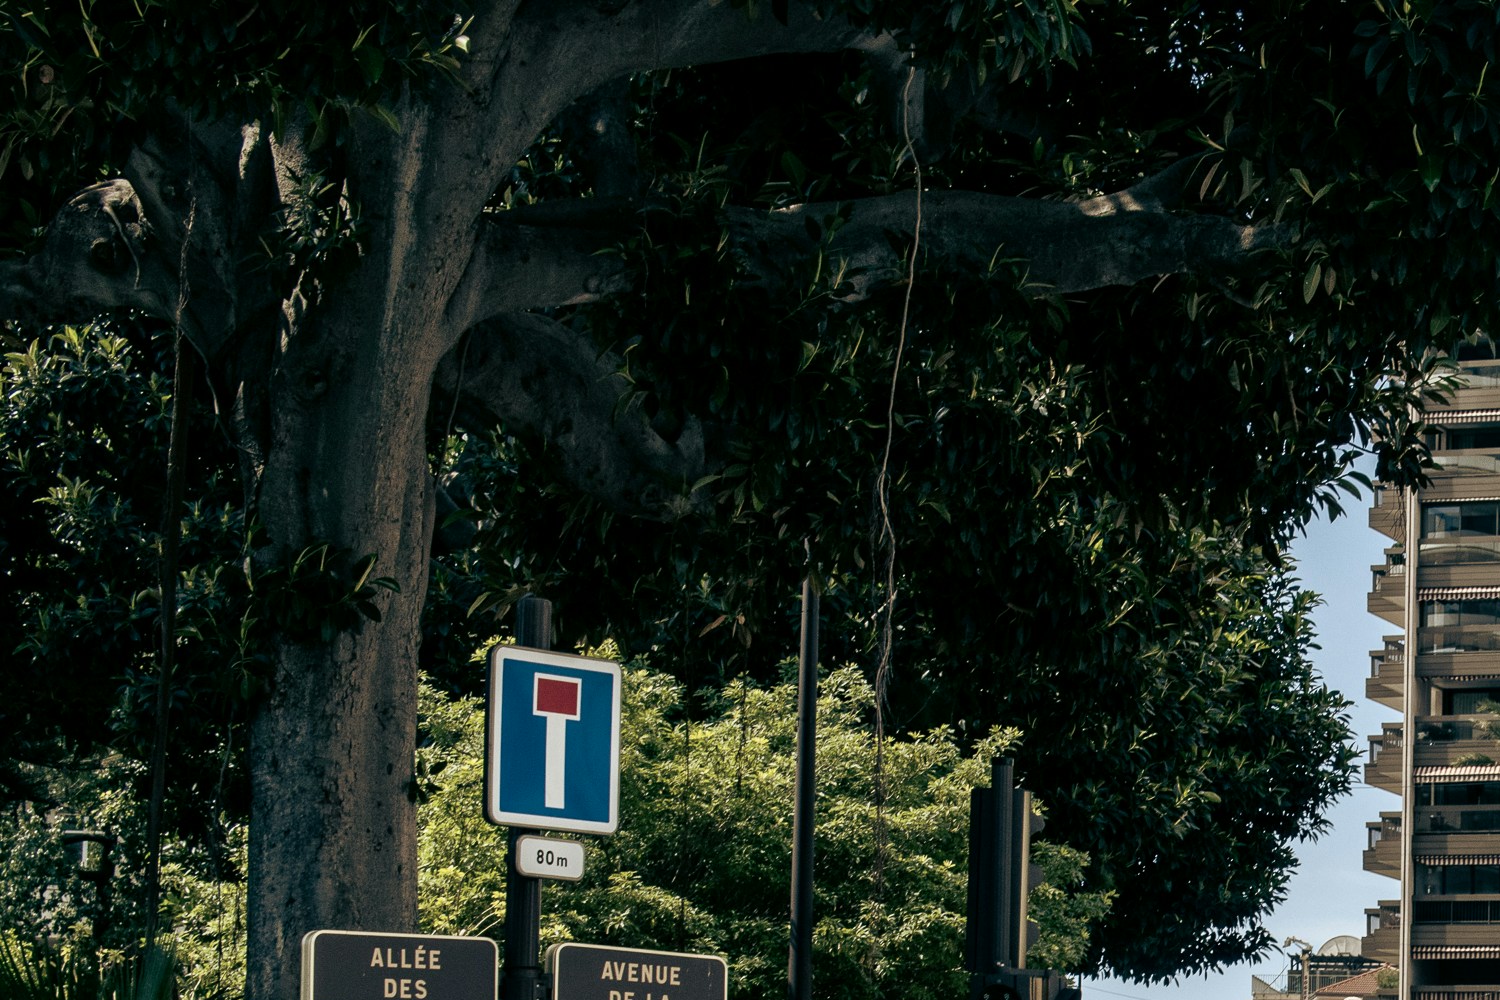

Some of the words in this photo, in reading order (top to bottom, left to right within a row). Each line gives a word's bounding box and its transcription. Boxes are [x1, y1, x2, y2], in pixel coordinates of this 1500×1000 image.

[370, 945, 441, 970] ALLÉE
[601, 960, 681, 986] AVENUE
[384, 978, 428, 999] DES
